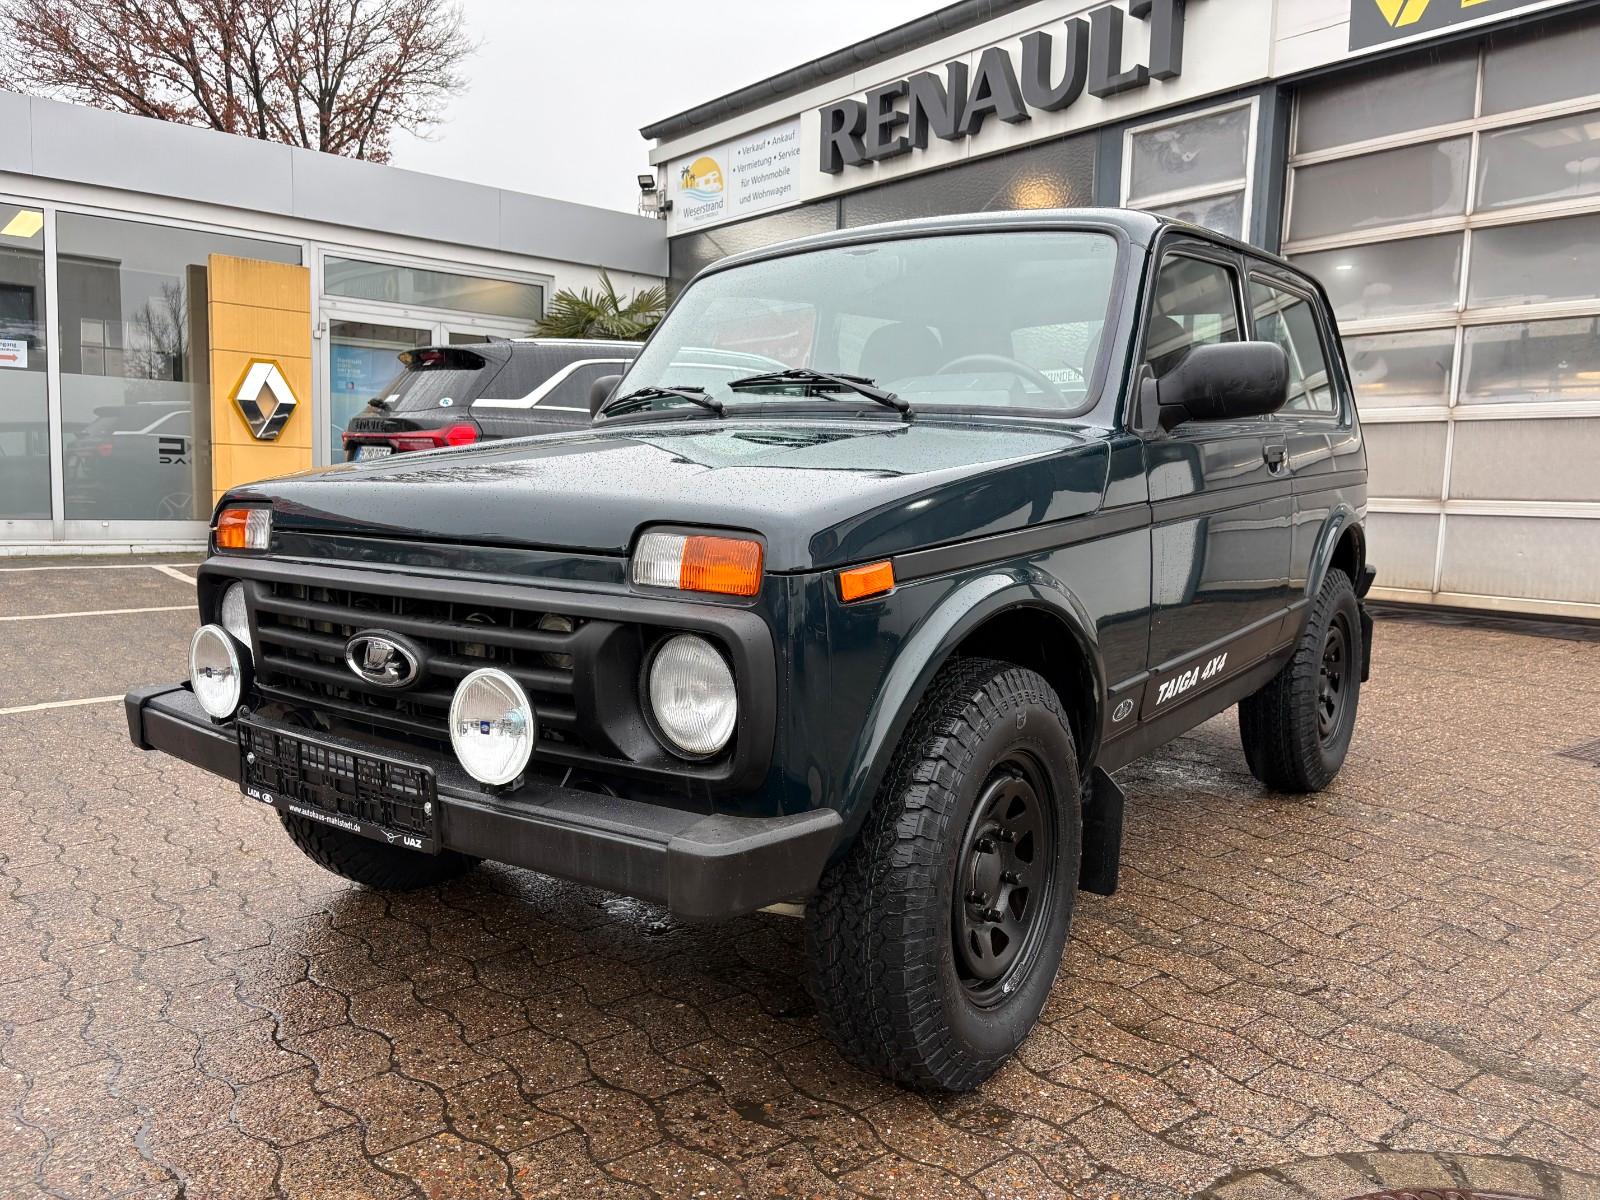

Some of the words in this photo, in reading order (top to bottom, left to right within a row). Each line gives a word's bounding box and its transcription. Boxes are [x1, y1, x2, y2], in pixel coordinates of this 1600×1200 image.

[819, 0, 1186, 175] RENAULT
[742, 140, 766, 155] Verkauf
[772, 130, 796, 145] Ankauf
[737, 155, 772, 173] Vermietung
[778, 147, 800, 160] Service
[741, 178, 751, 188] für
[751, 167, 791, 185] Wohnmobile
[740, 194, 751, 204] und
[752, 184, 792, 201] Wohnwagen
[683, 197, 724, 218] Weserstrand
[1156, 666, 1200, 705] TAIGA
[1201, 653, 1228, 680] 4X4
[247, 787, 261, 800] LADA
[403, 836, 422, 848] UAZ
